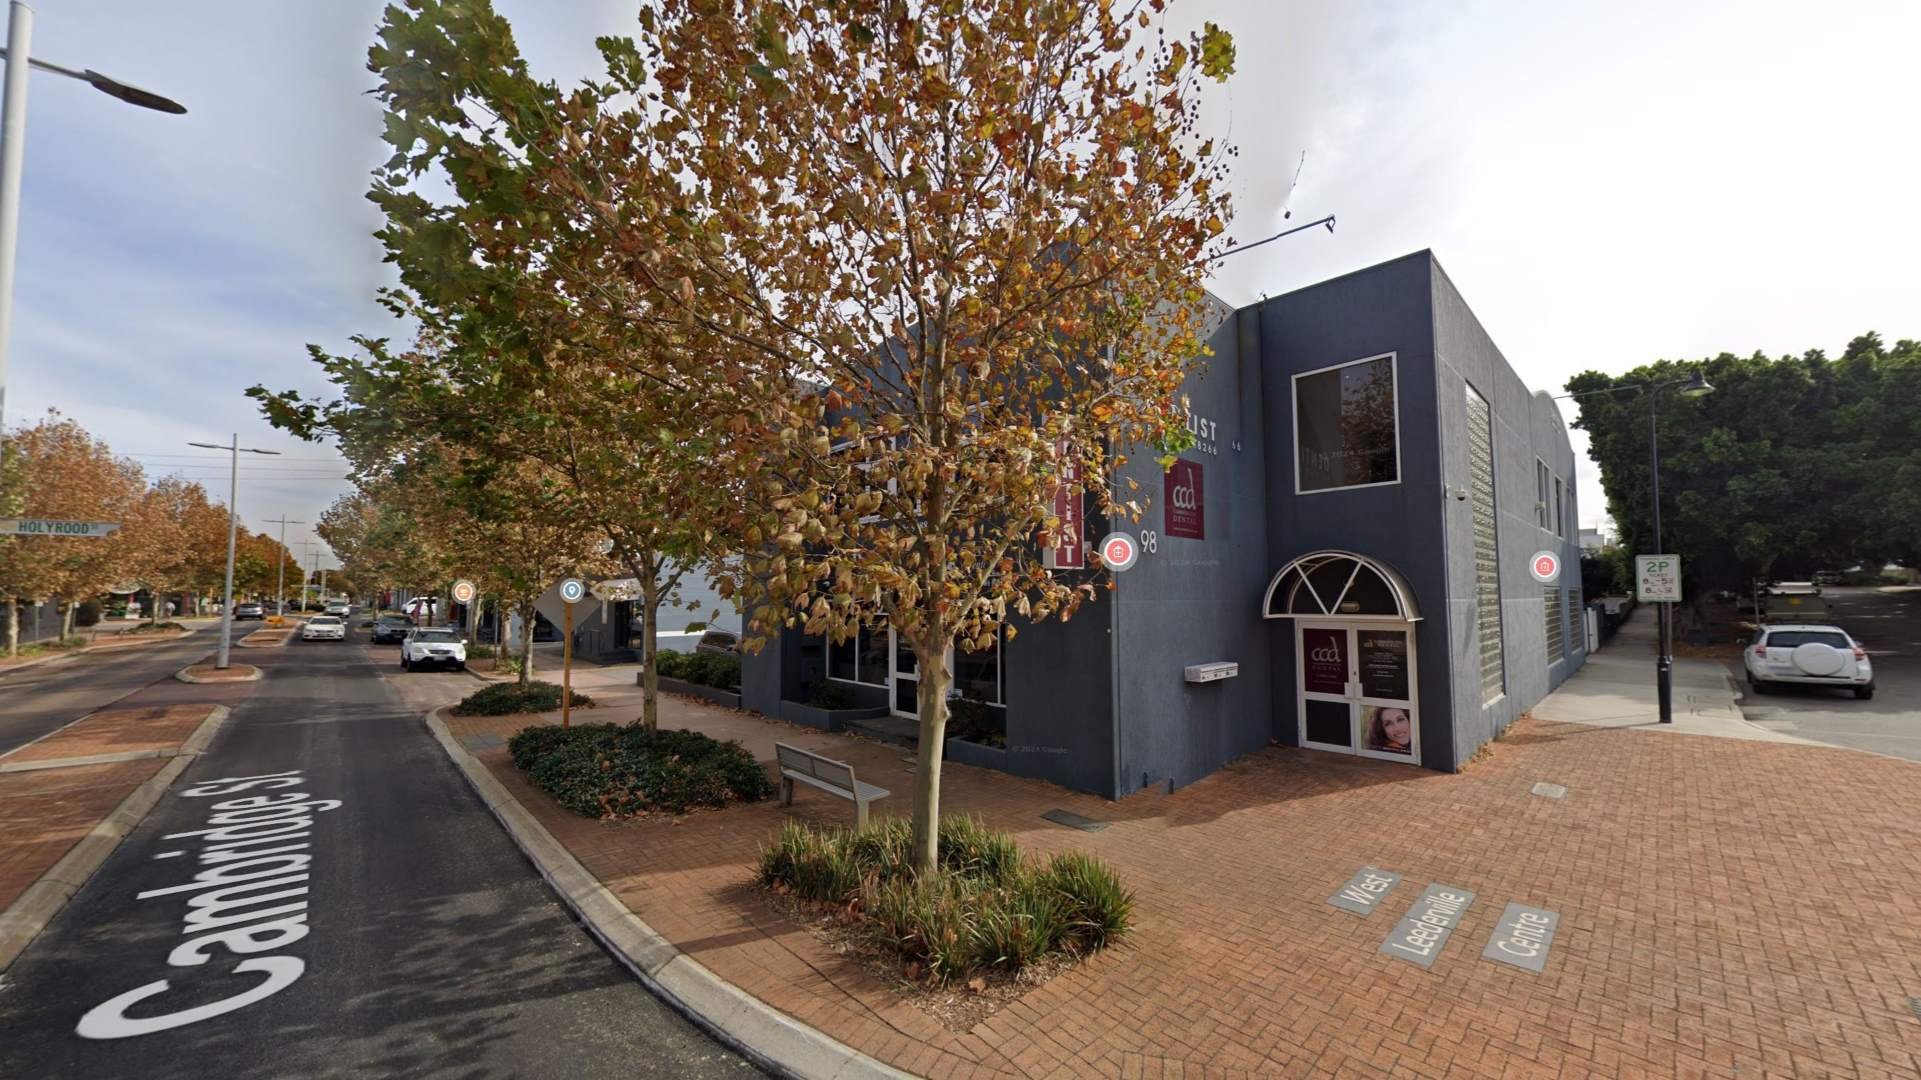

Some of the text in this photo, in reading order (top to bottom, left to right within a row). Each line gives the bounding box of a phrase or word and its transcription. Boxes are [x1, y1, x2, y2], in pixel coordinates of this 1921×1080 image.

[18, 521, 90, 534] HOLYROOD
[1140, 529, 1157, 554] 98
[1647, 561, 1669, 573] 2P
[1340, 873, 1393, 905] West
[1391, 891, 1466, 957] Leederville
[1496, 912, 1549, 958] Centre
